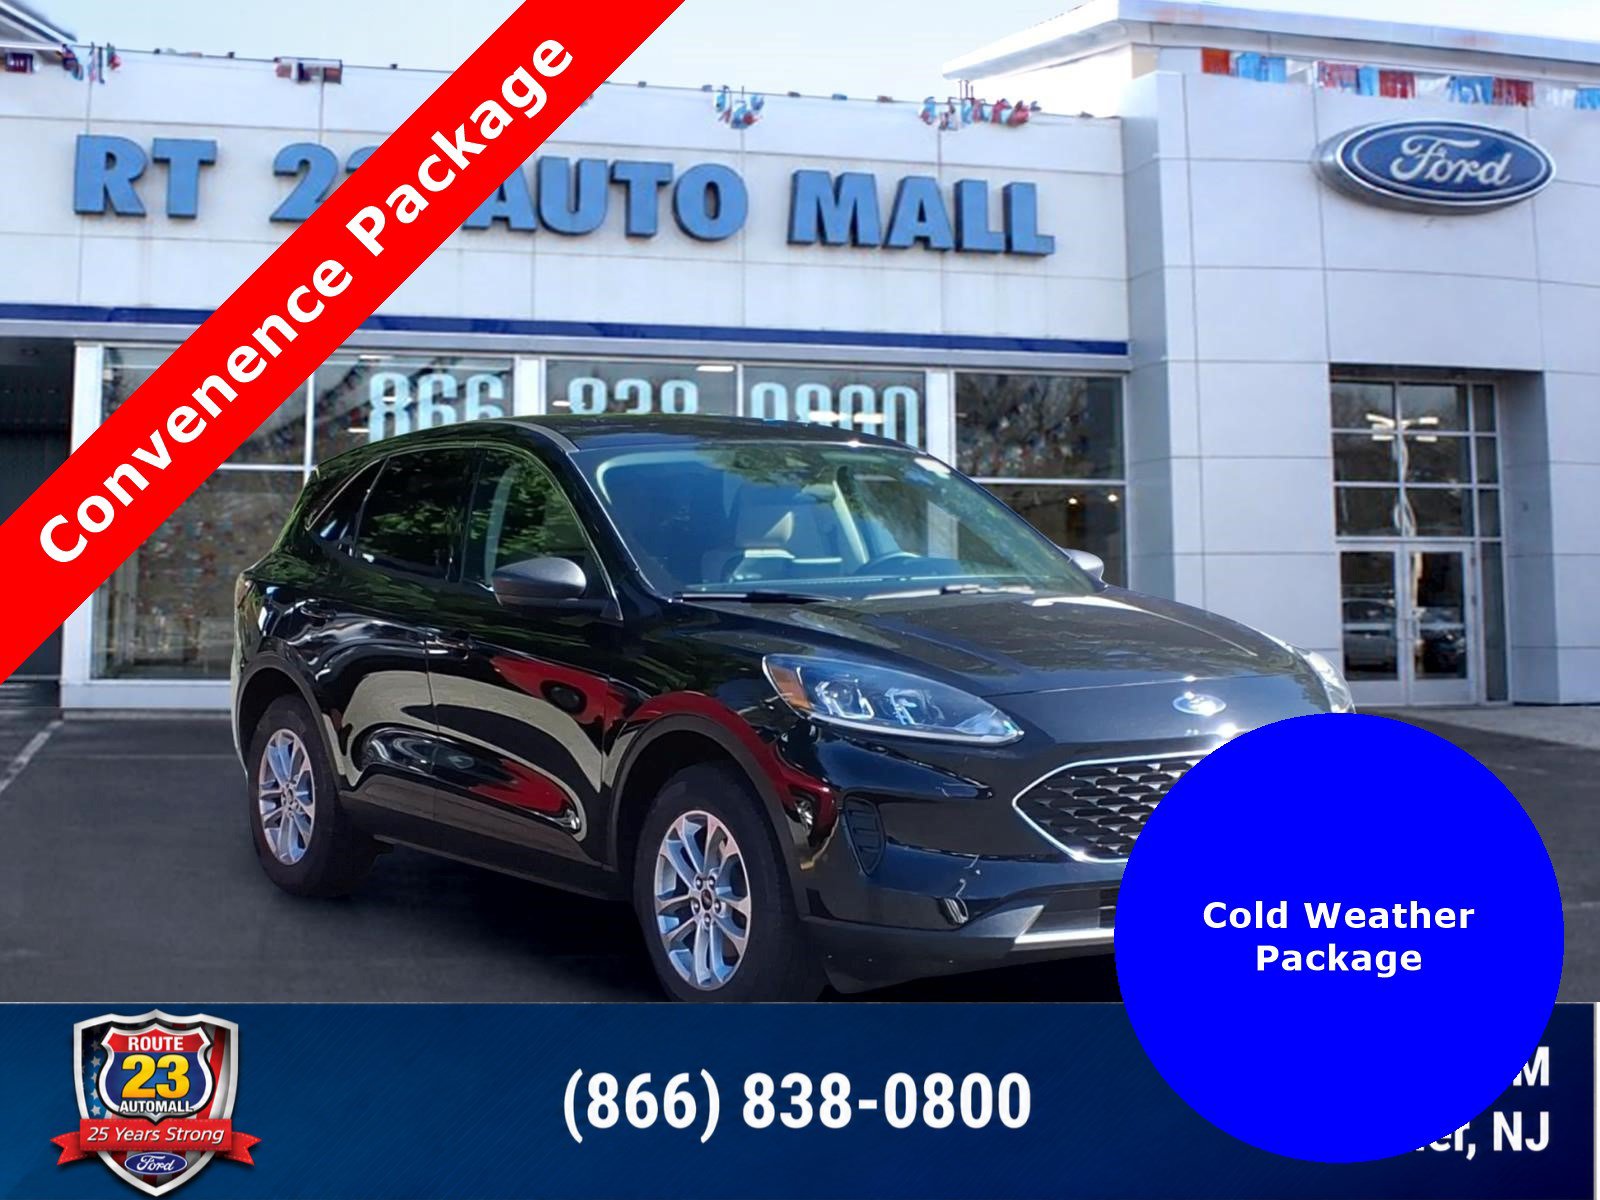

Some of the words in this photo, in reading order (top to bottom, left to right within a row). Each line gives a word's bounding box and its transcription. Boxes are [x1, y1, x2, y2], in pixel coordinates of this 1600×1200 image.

[73, 133, 218, 219] RT
[269, 142, 381, 222] 2
[461, 156, 749, 243] AUTO
[787, 169, 1056, 257] MALL
[1390, 134, 1513, 186] Ford
